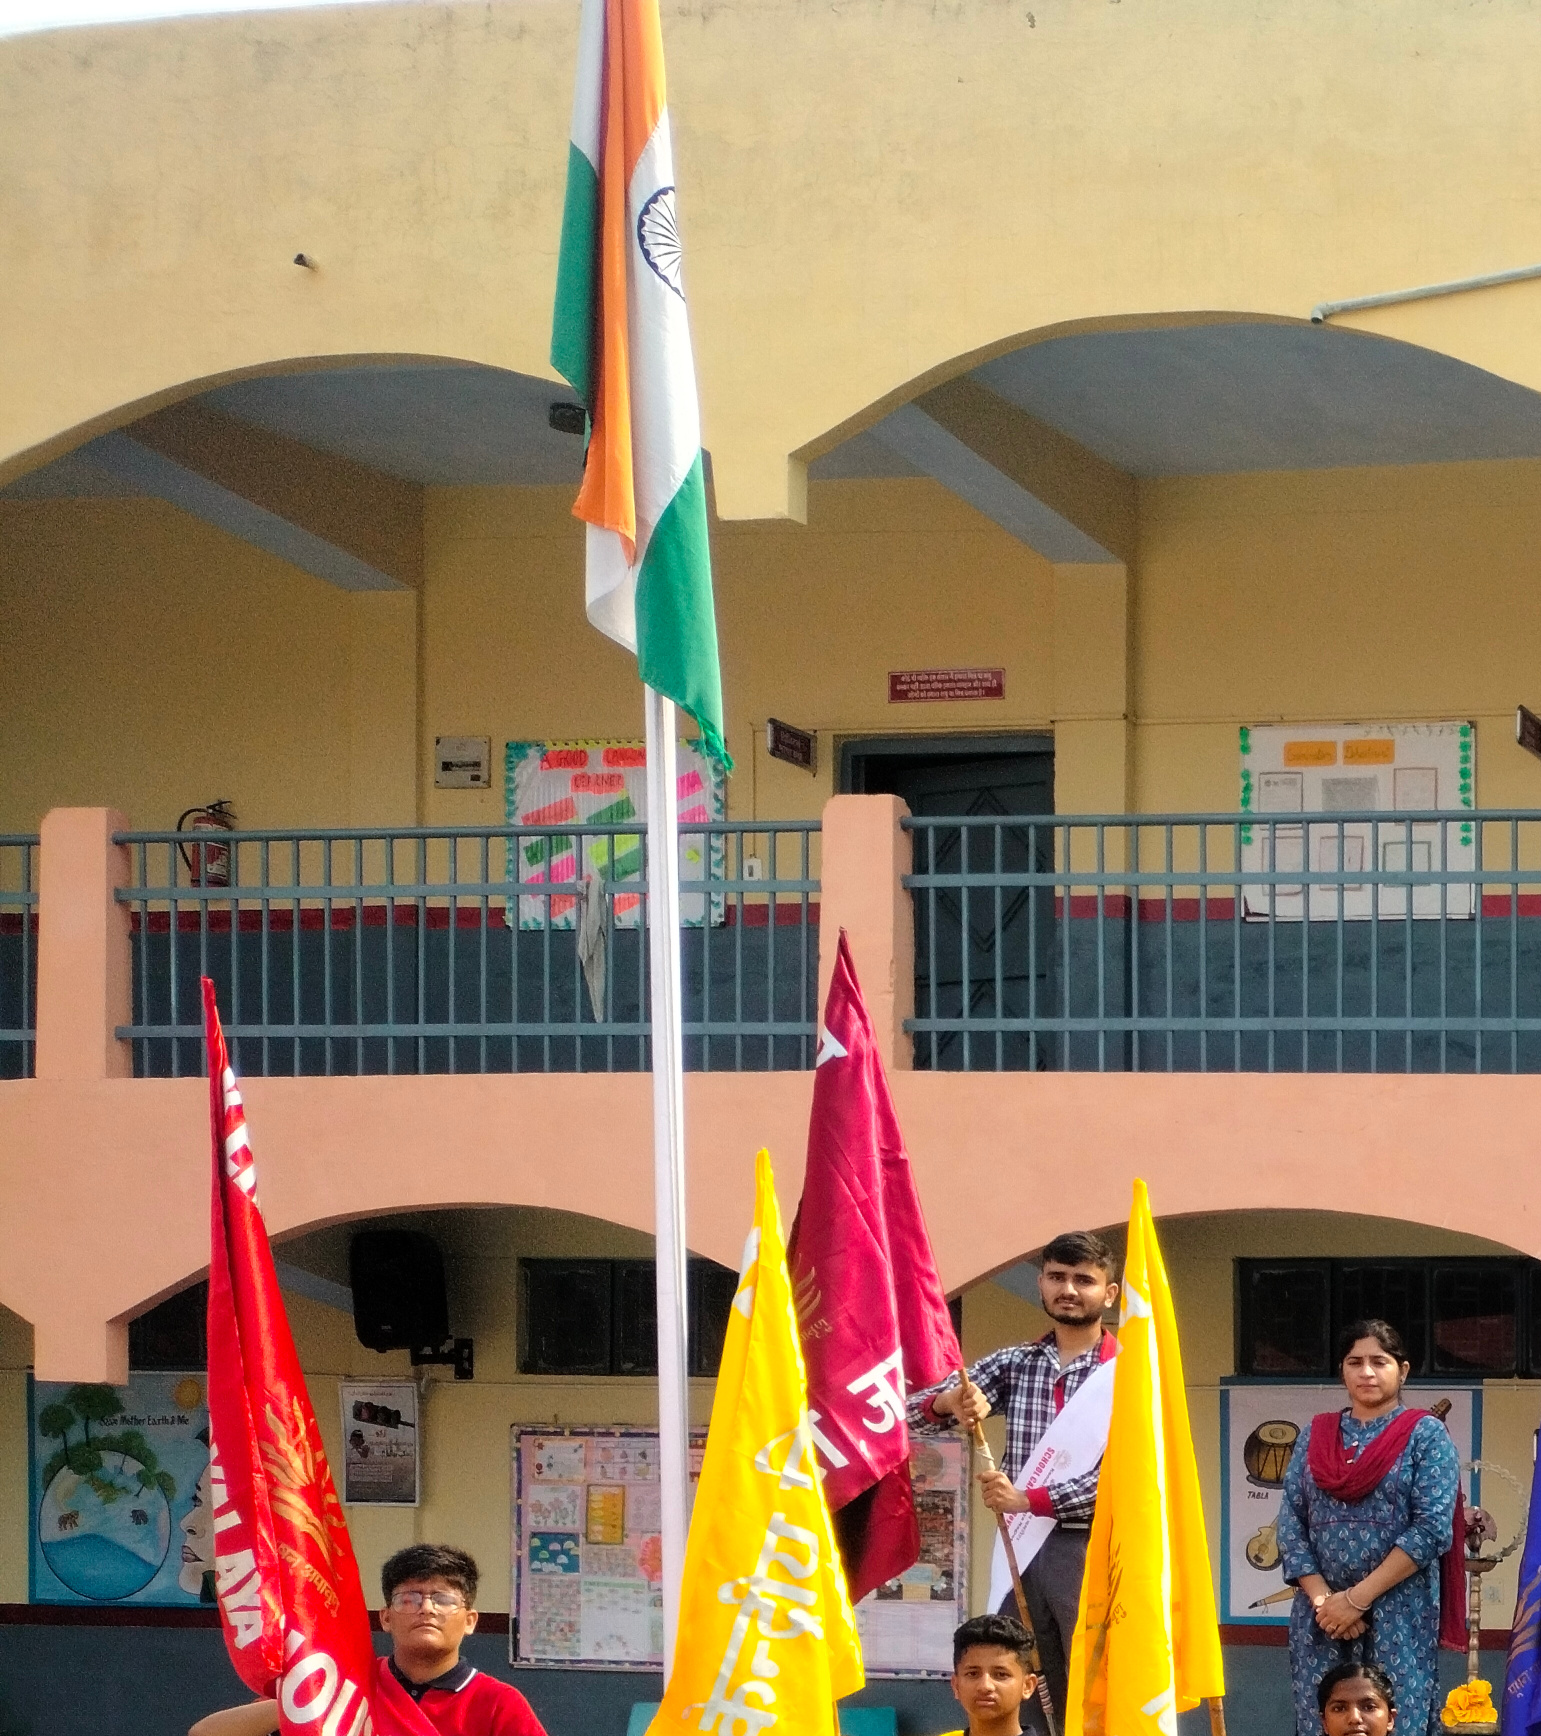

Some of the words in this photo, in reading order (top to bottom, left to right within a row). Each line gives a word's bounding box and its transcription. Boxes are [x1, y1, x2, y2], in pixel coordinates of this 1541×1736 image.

[120, 1415, 145, 1426] Mother
[147, 1415, 167, 1426] Earth
[177, 1415, 189, 1426] Me
[1036, 1447, 1056, 1480] SCHOOL
[1247, 1491, 1269, 1499] TABLA
